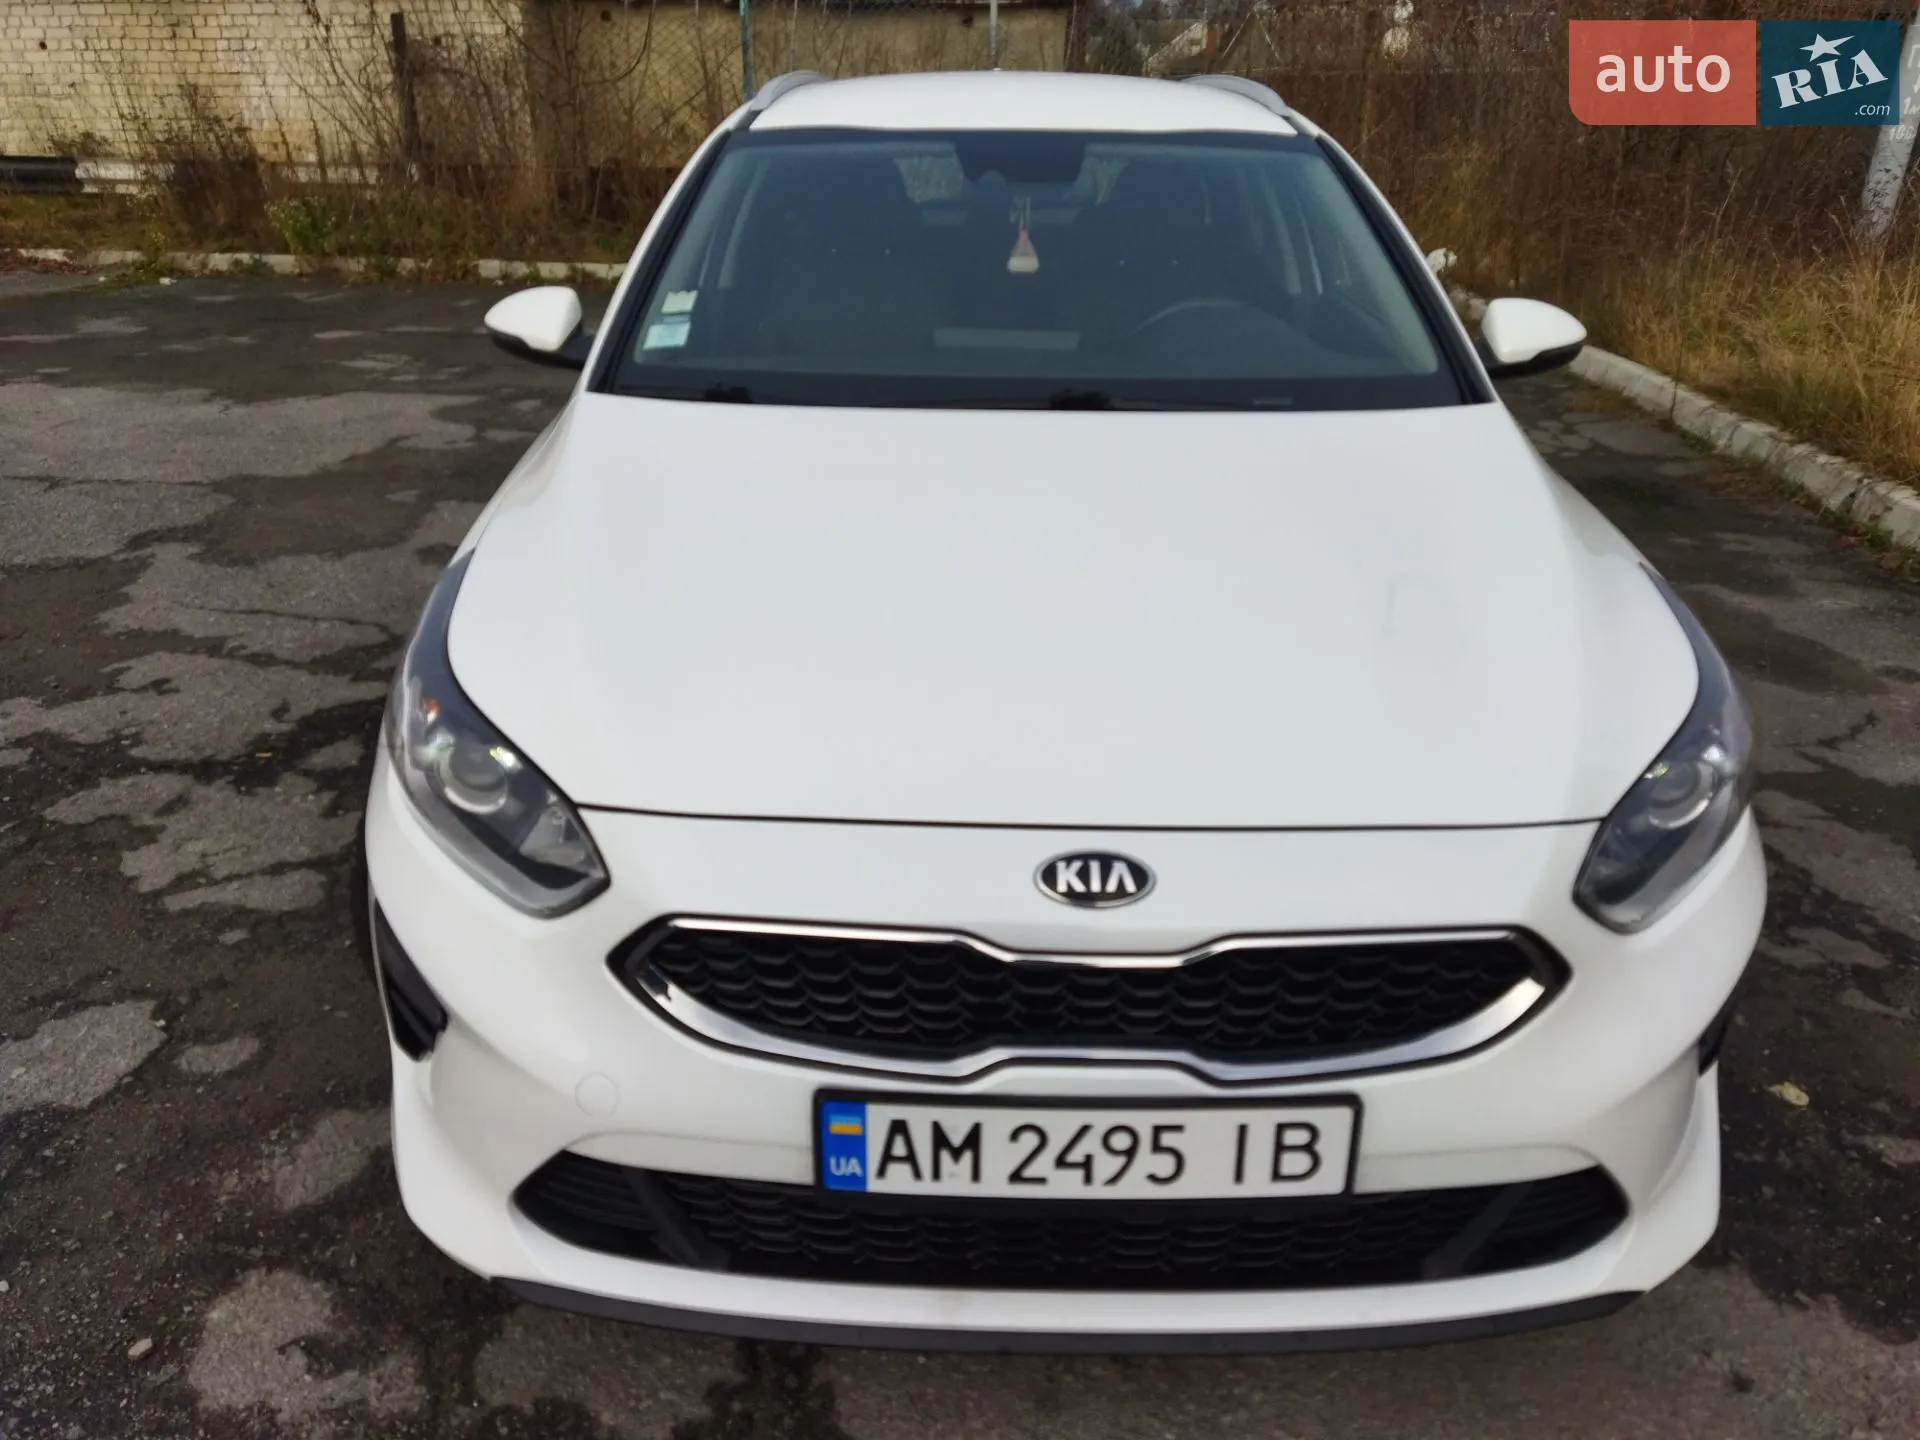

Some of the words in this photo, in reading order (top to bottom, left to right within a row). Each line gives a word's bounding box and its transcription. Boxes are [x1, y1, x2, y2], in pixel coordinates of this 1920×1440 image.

[1055, 859, 1138, 894] KIA
[830, 1155, 864, 1178] UA
[875, 1119, 982, 1182] AM
[1006, 1123, 1186, 1187] 2495
[1232, 1121, 1321, 1184] IB
